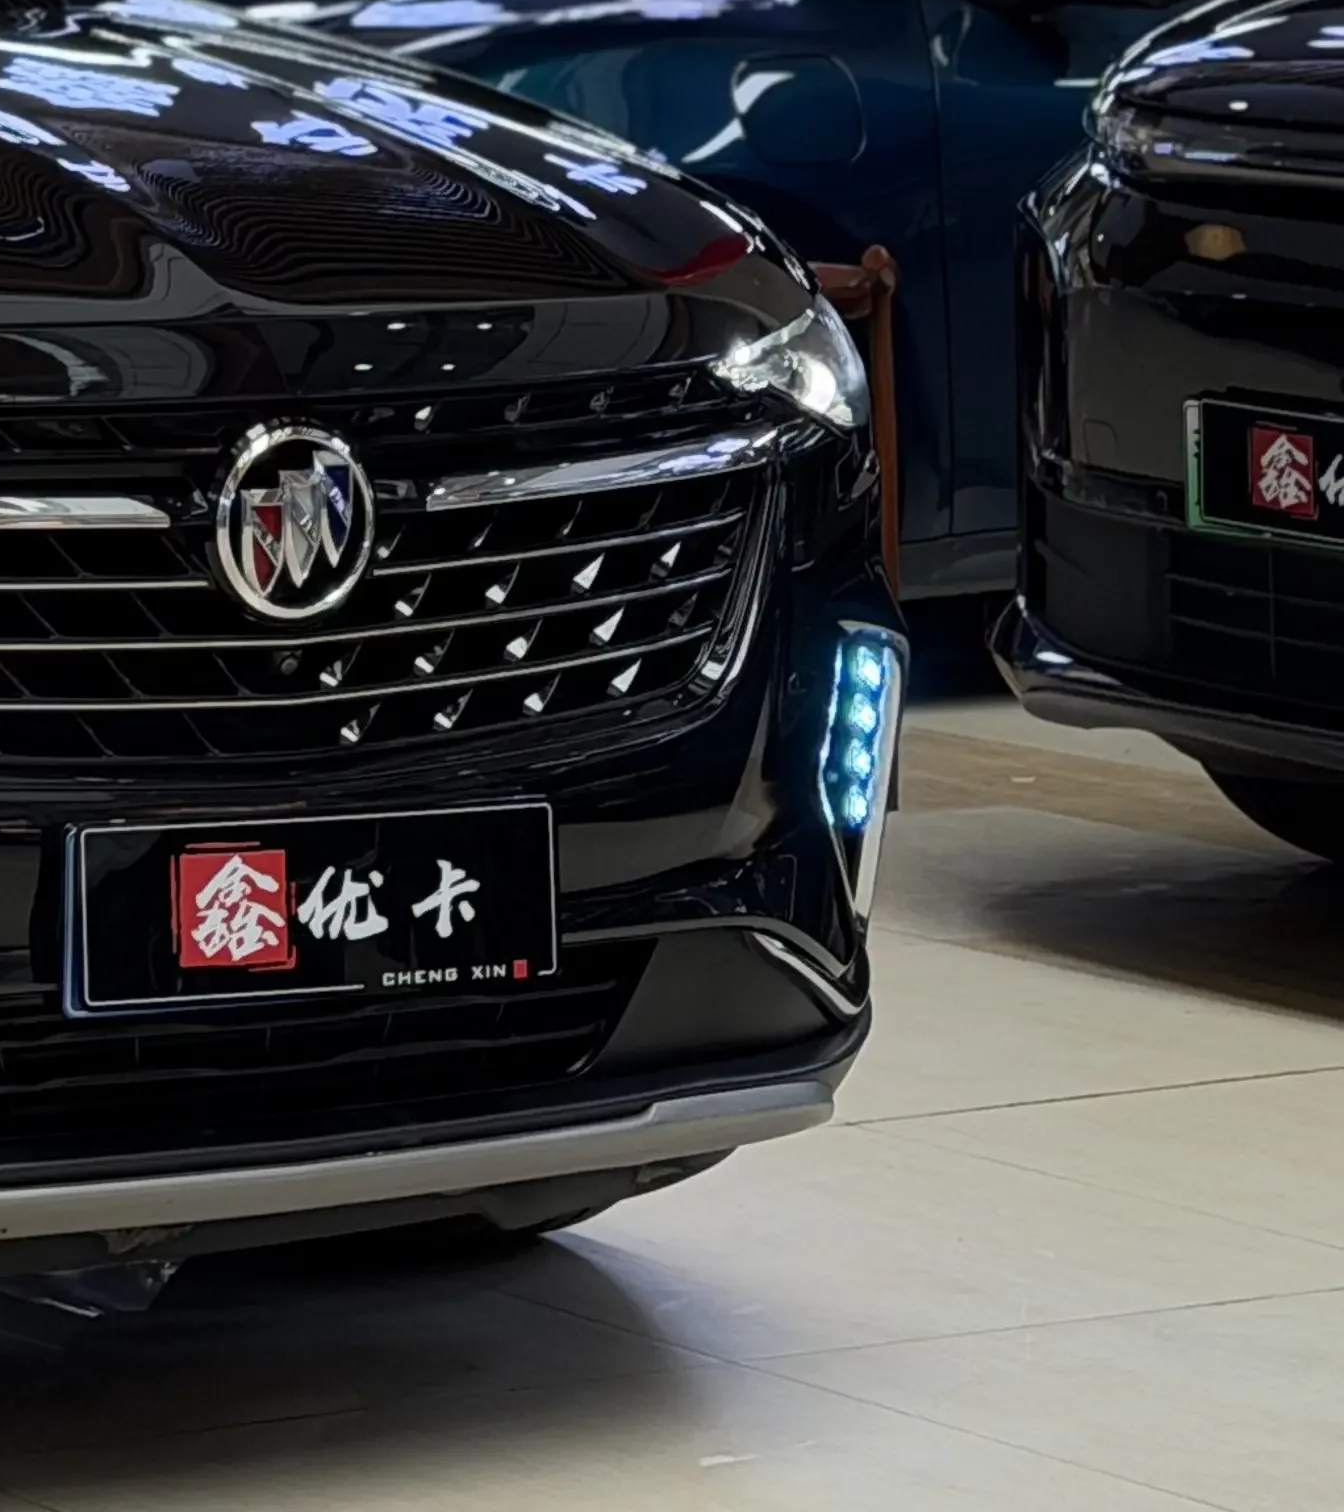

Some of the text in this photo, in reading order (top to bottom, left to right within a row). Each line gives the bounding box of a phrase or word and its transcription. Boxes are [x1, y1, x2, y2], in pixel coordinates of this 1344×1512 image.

[192, 855, 480, 961] 鑫优卡
[382, 963, 507, 987] CHENG XIN
